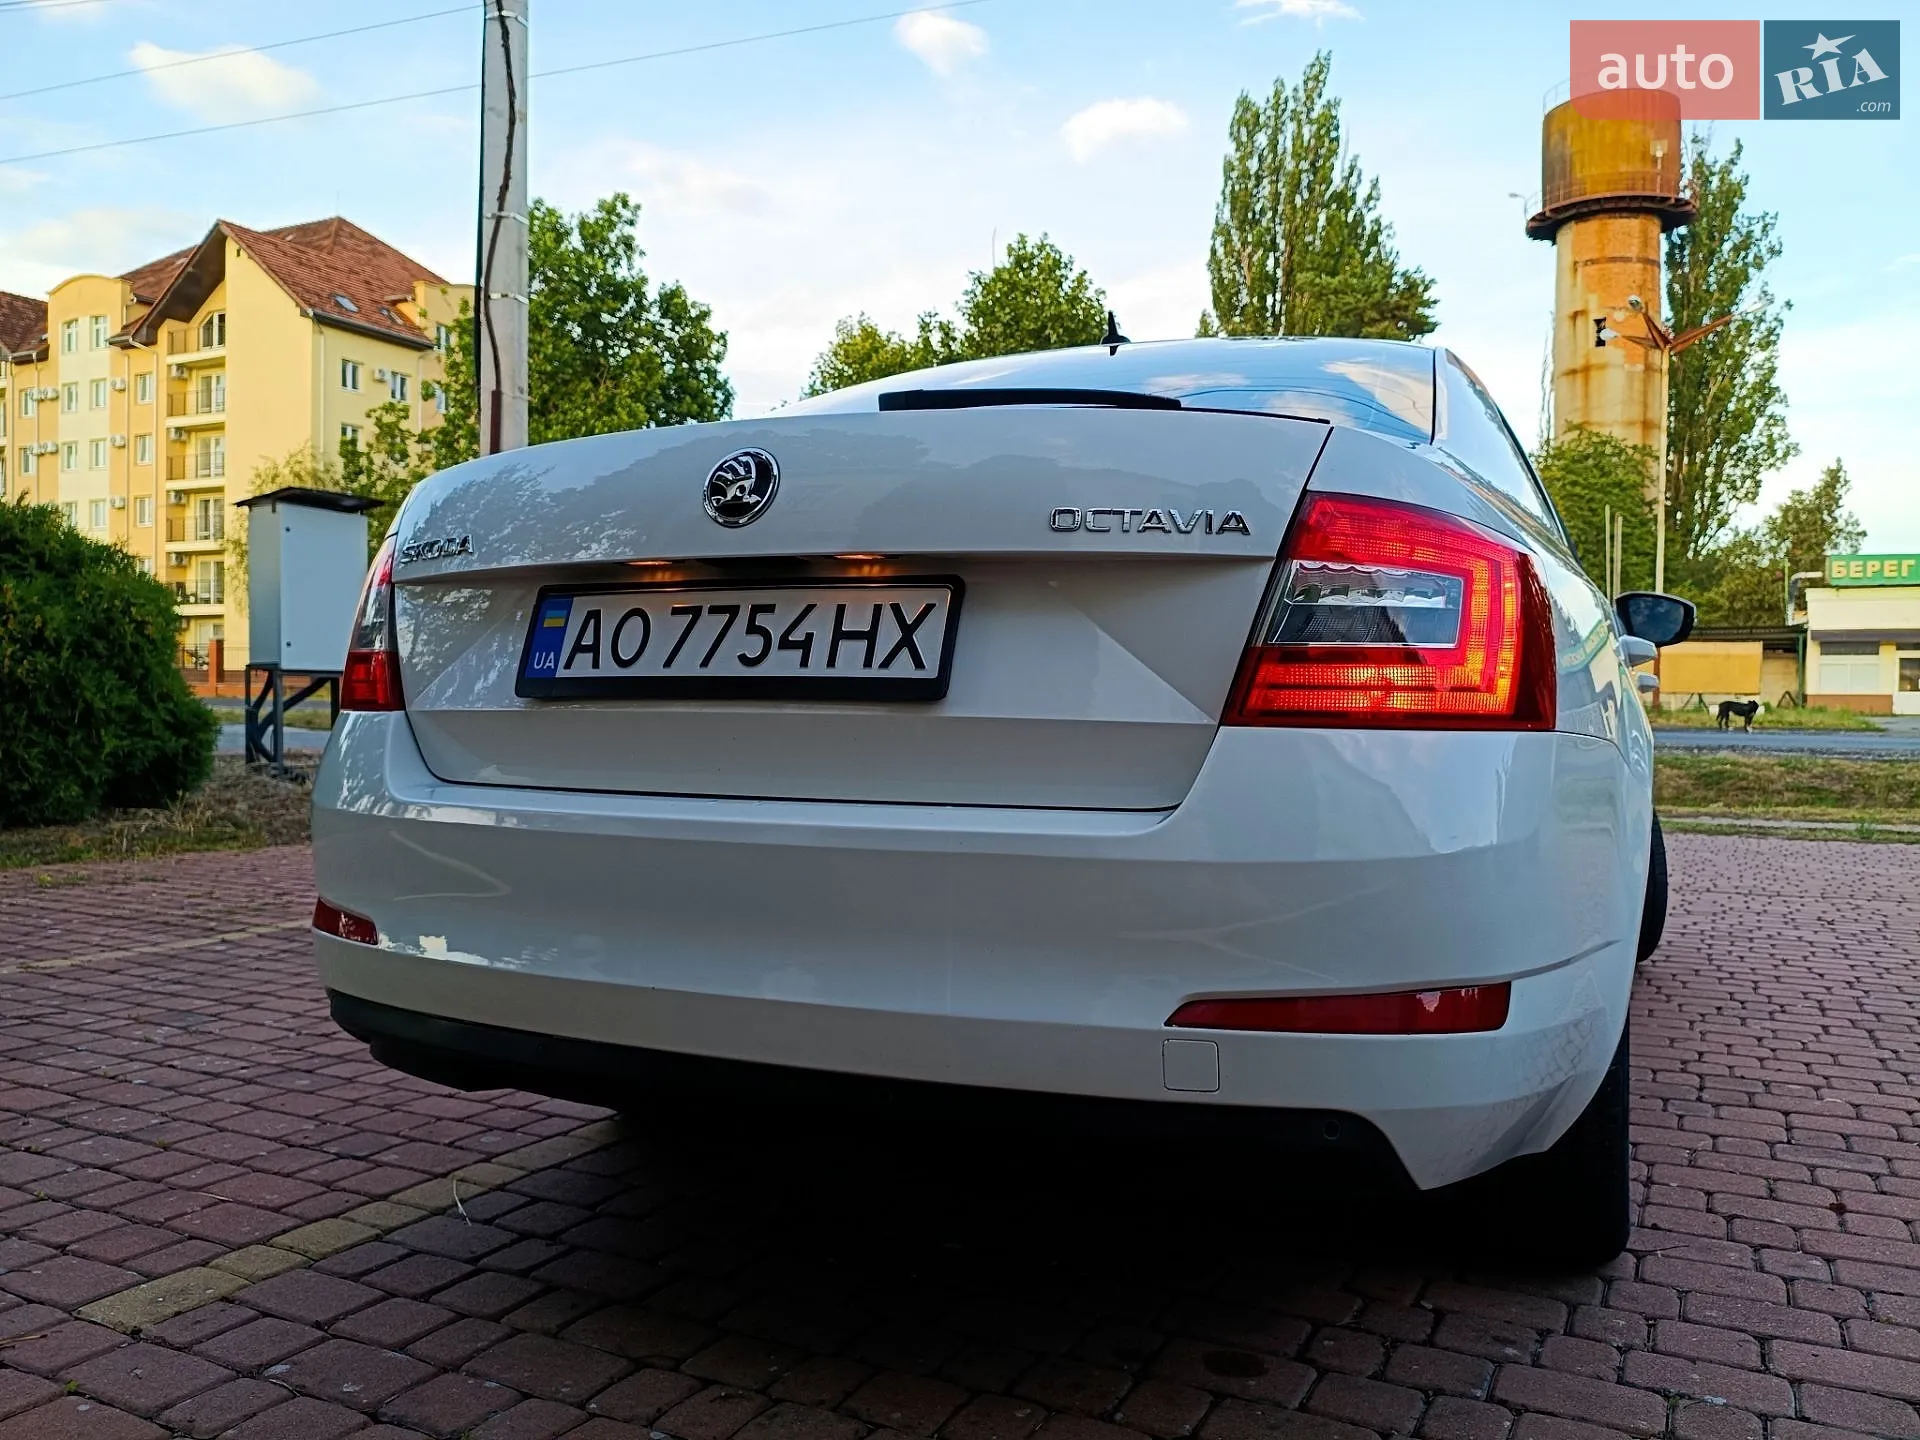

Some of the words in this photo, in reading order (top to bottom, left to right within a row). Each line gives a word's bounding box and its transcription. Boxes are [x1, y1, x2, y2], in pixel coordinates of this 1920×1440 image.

[1050, 506, 1250, 535] OCTAVIA
[1831, 560, 1916, 578] БЕРЕГ
[563, 608, 652, 670] AO
[662, 603, 818, 669] 7754
[826, 602, 937, 671] HX
[534, 652, 556, 670] UA
